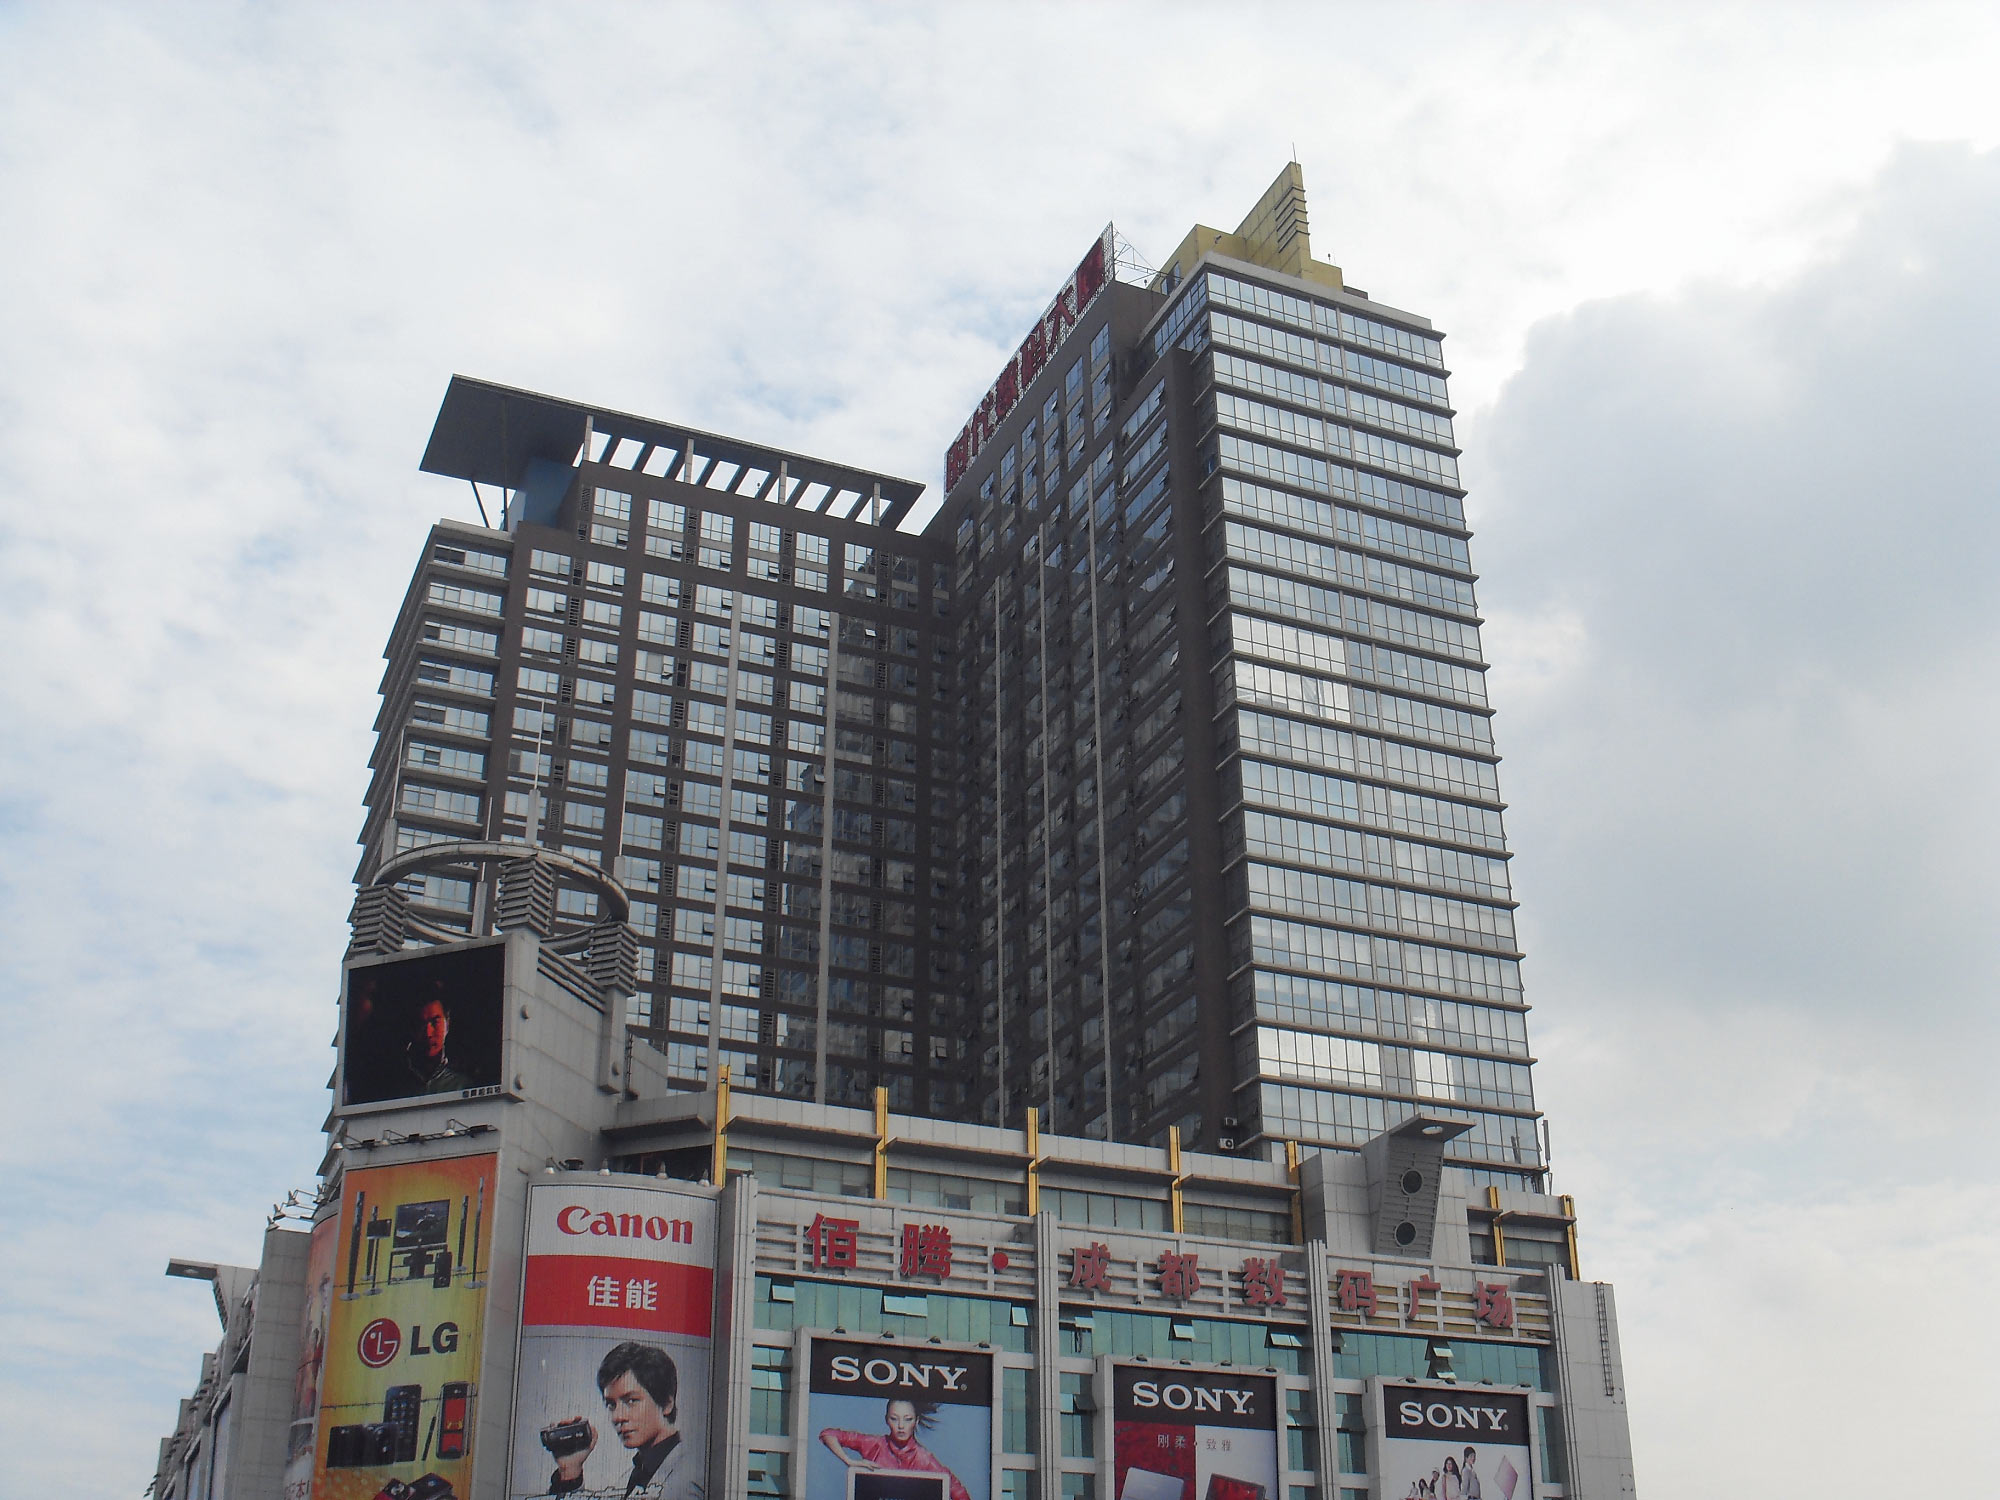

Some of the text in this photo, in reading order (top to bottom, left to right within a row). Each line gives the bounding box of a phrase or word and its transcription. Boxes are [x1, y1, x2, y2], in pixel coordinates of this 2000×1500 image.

[557, 1206, 693, 1244] Canon
[587, 1276, 658, 1311] 佳能
[410, 1322, 458, 1355] LG
[831, 1356, 967, 1390] SONY
[1133, 1381, 1254, 1414] SONY
[1400, 1401, 1507, 1430] SONY
